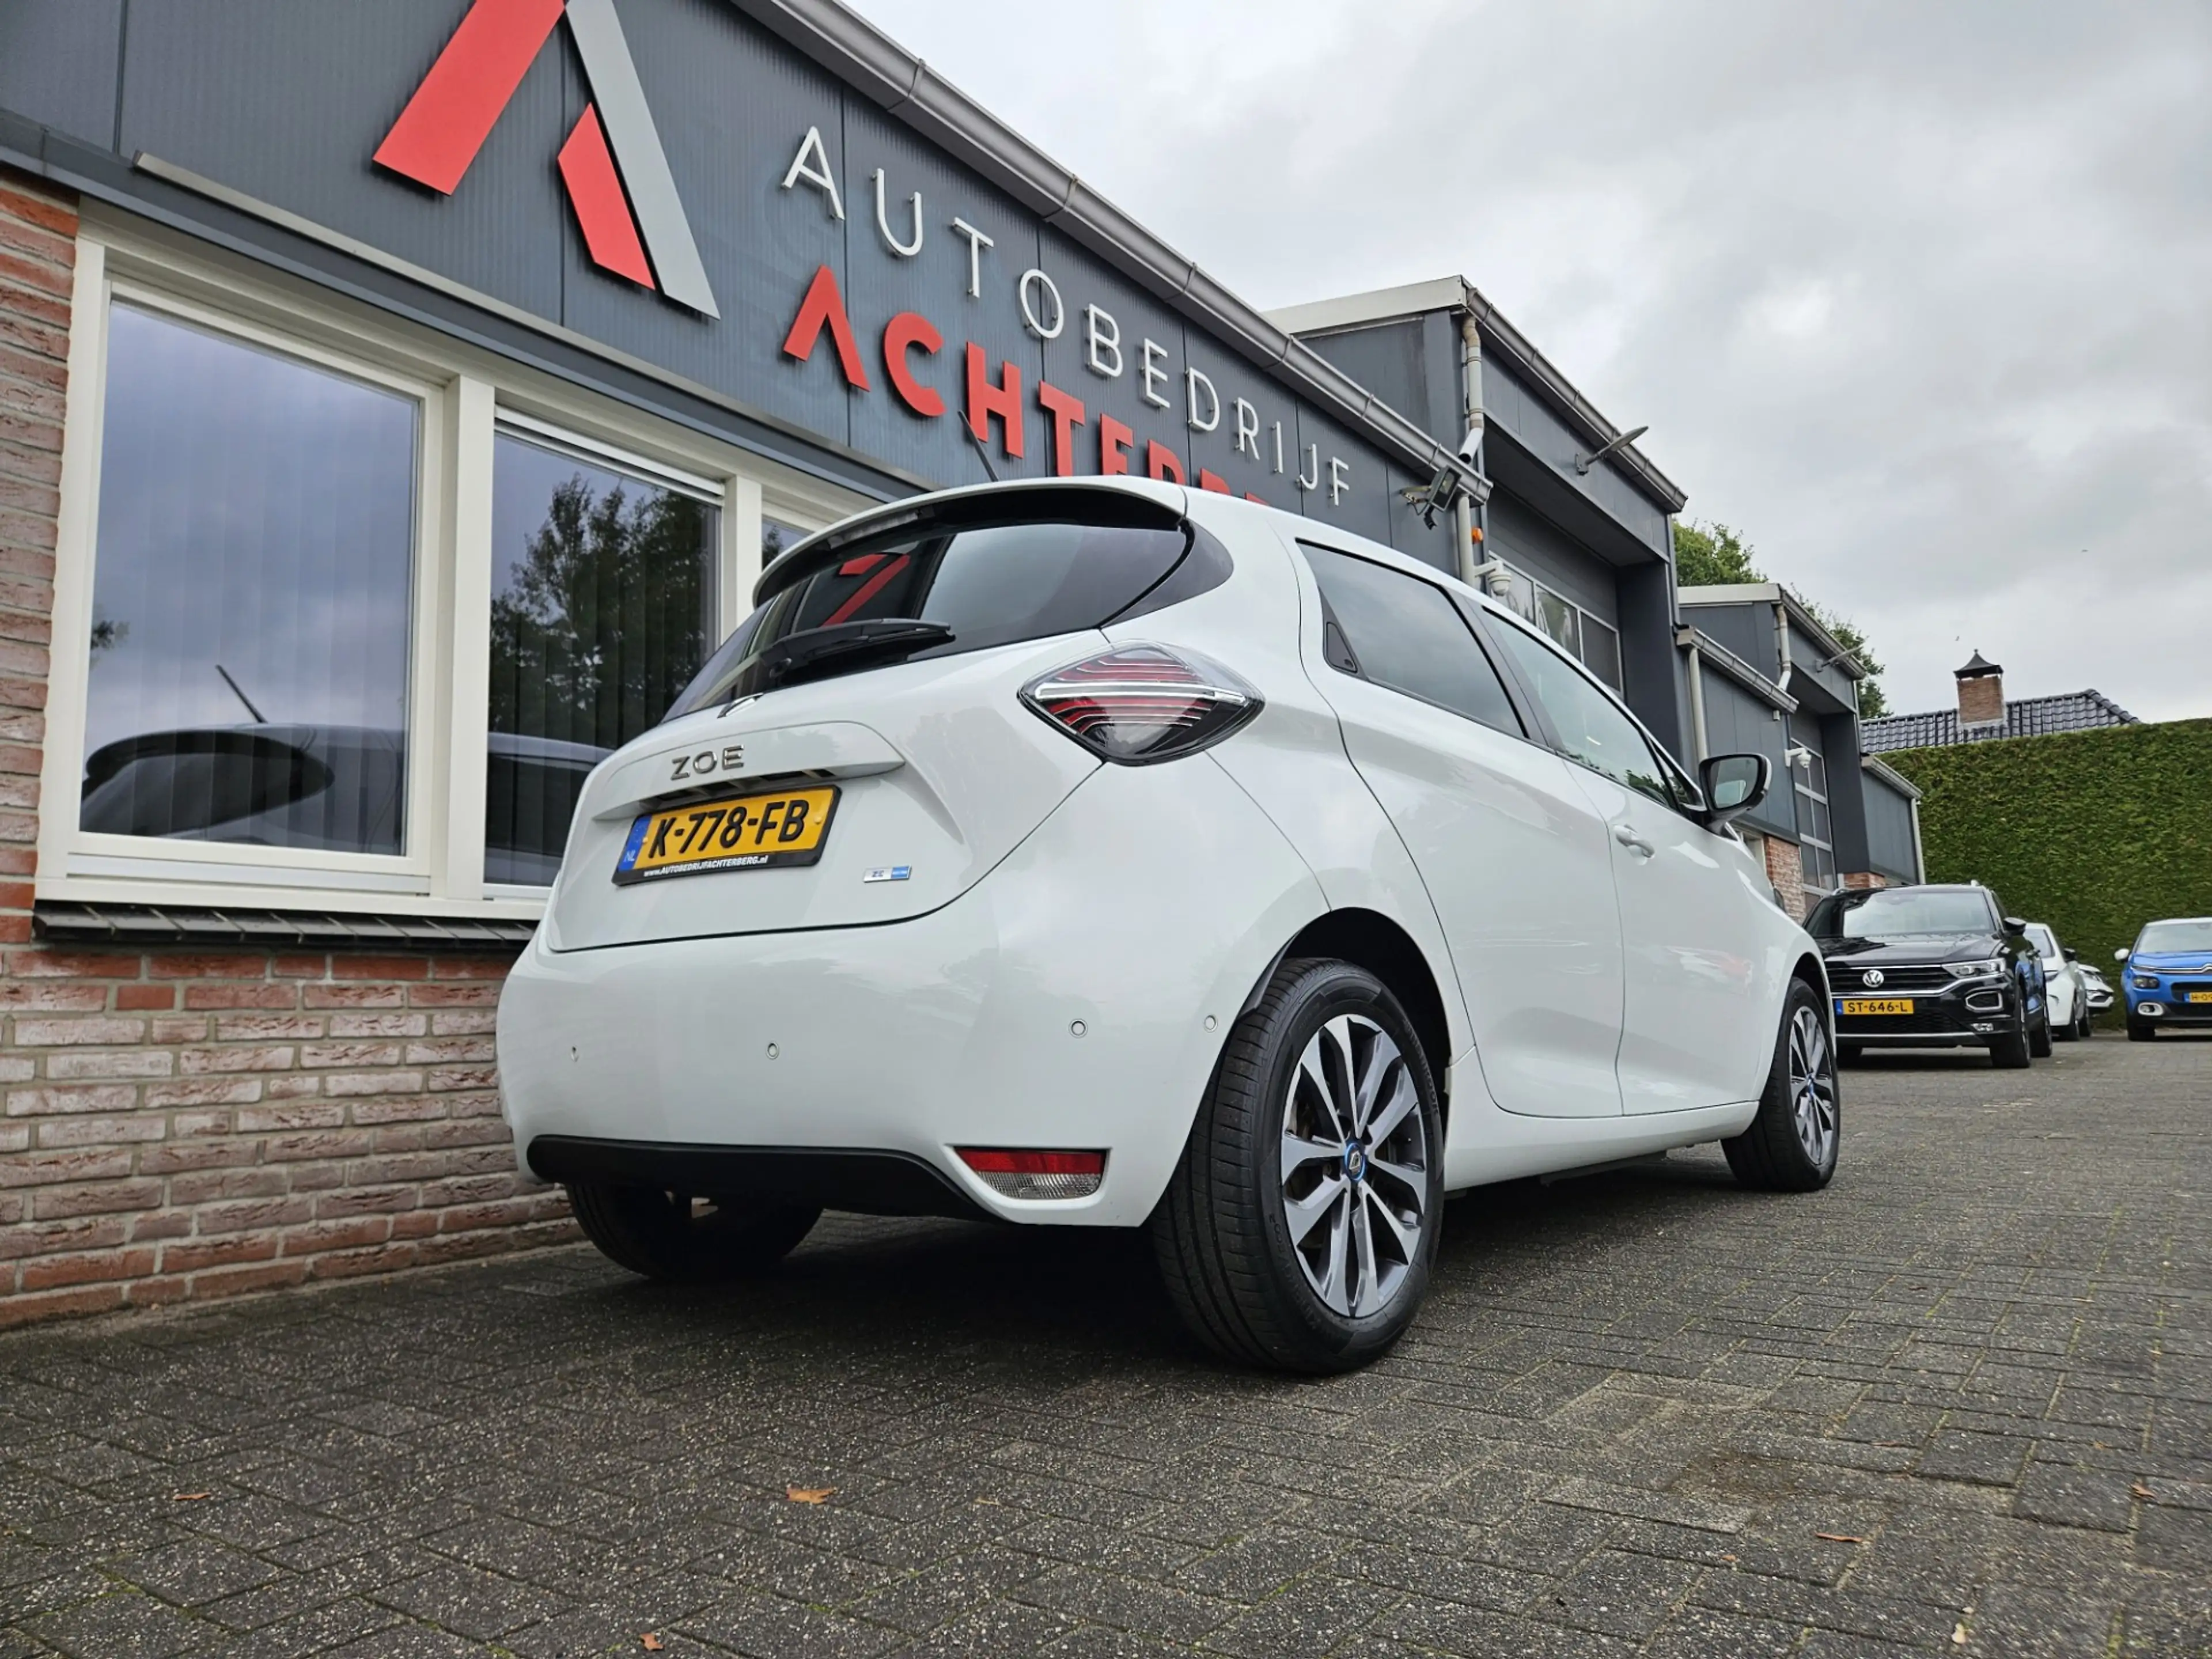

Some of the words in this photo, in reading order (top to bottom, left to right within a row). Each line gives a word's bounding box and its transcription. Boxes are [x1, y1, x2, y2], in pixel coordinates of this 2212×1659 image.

[781, 125, 1350, 506] AUTOBEDRIJF
[782, 264, 1271, 506] ACHTE
[671, 745, 745, 780] ZOE
[647, 799, 809, 858] K-778-FB
[643, 855, 768, 877] www.AUTOBEDRIJFACHTERBERG.nl
[1848, 1002, 1907, 1012] ST-646-L
